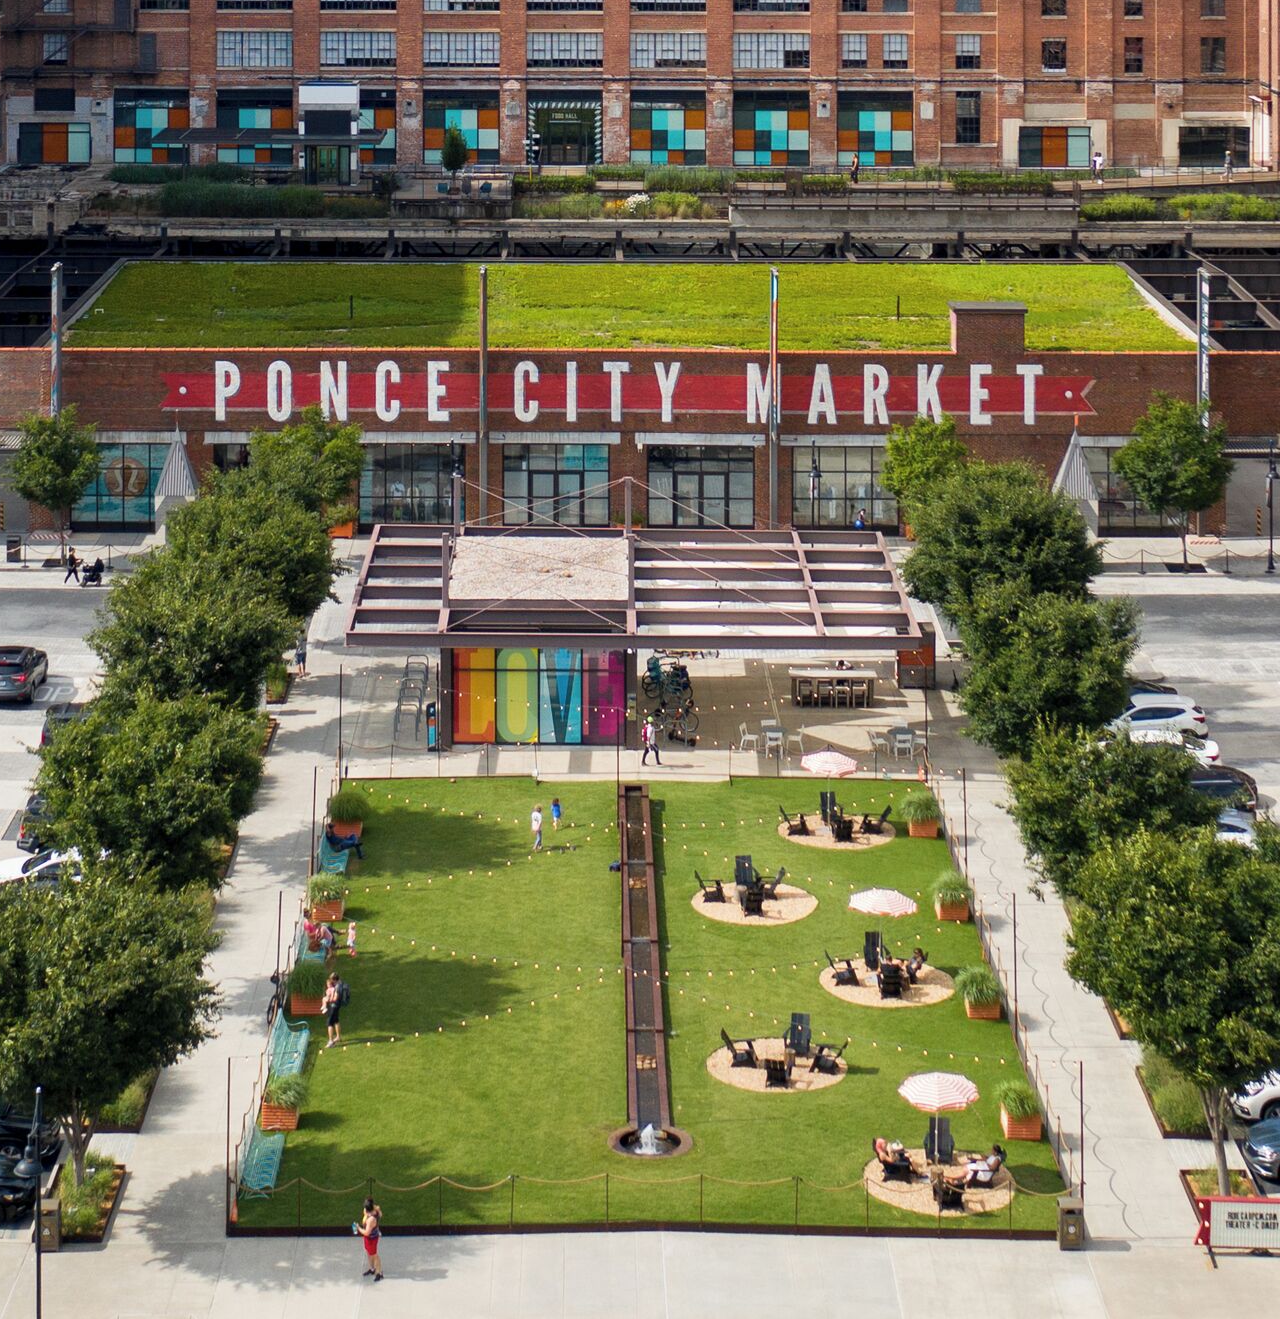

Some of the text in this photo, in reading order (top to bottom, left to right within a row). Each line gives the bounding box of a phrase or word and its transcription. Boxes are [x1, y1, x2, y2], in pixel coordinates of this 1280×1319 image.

[213, 360, 1046, 426] PONCE CITY MARKET
[453, 648, 624, 744] LOVE
